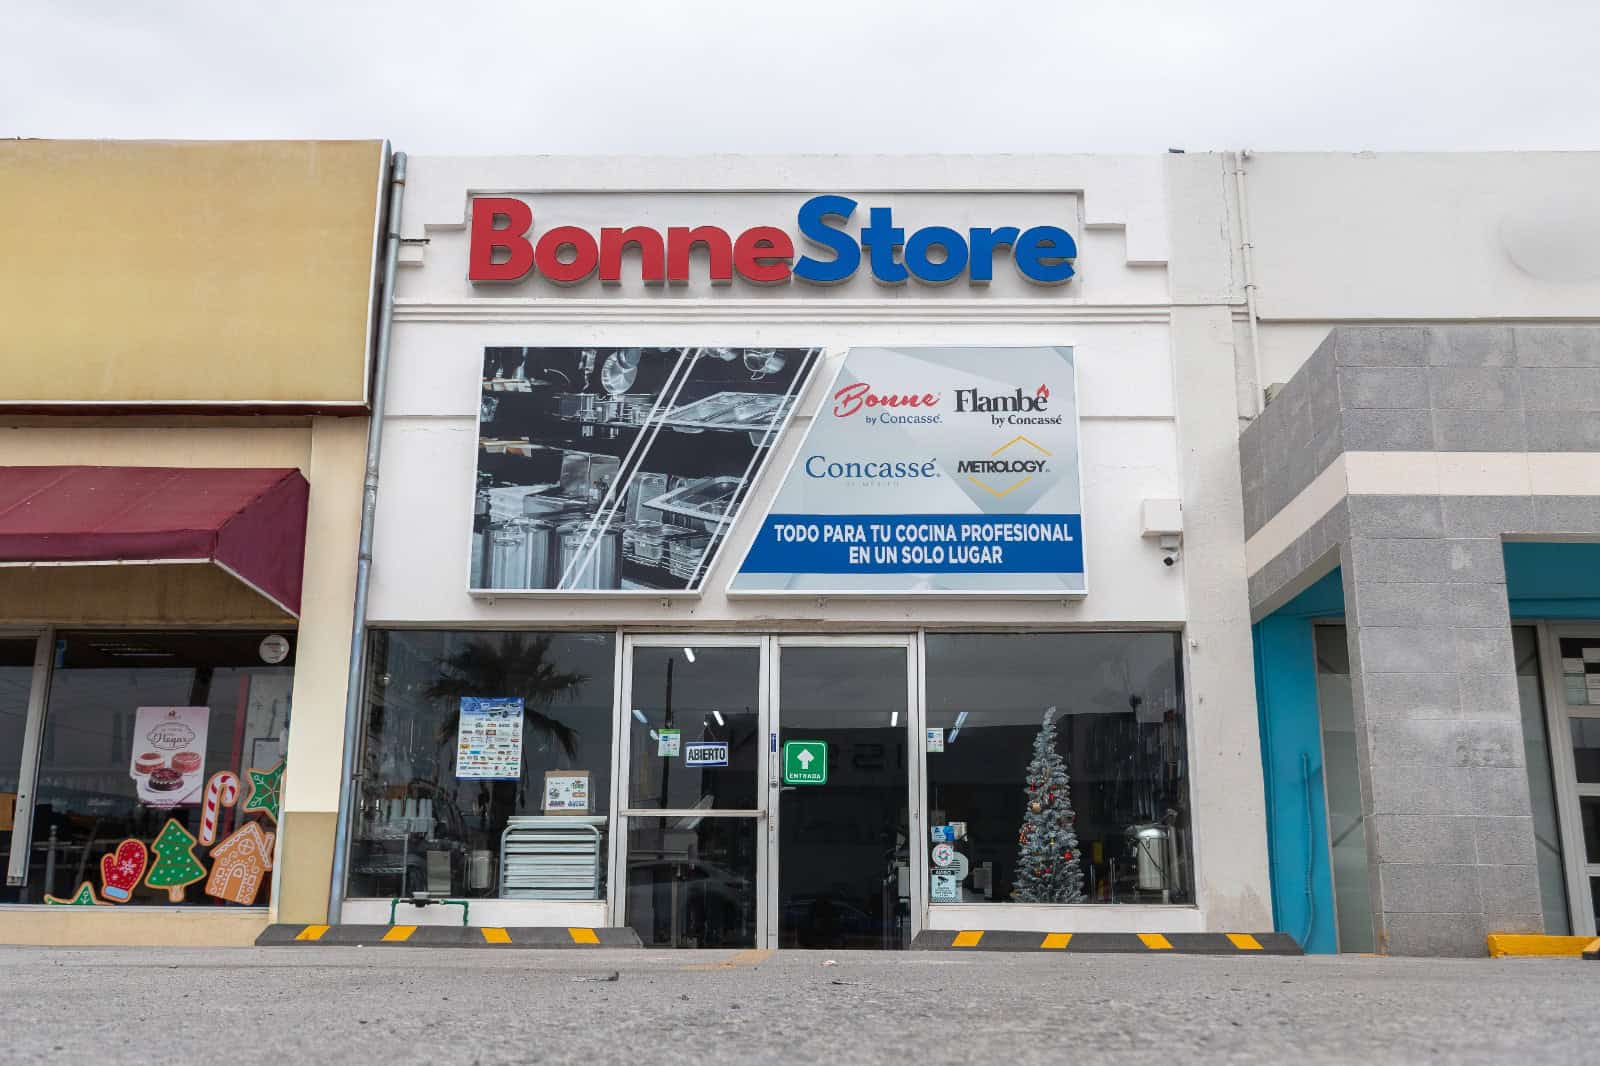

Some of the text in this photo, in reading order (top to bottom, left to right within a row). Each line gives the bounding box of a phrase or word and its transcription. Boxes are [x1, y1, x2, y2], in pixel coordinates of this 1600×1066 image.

[833, 382, 940, 418] Bonne
[865, 415, 877, 425] by
[991, 415, 1006, 428] by
[957, 460, 1047, 473] METROLOGY
[774, 523, 1073, 543] TODO PARA TU COCINA PROFESIONAL
[849, 546, 1003, 564] EN UN SOLO LUGAR
[687, 746, 726, 761] ABIERTO
